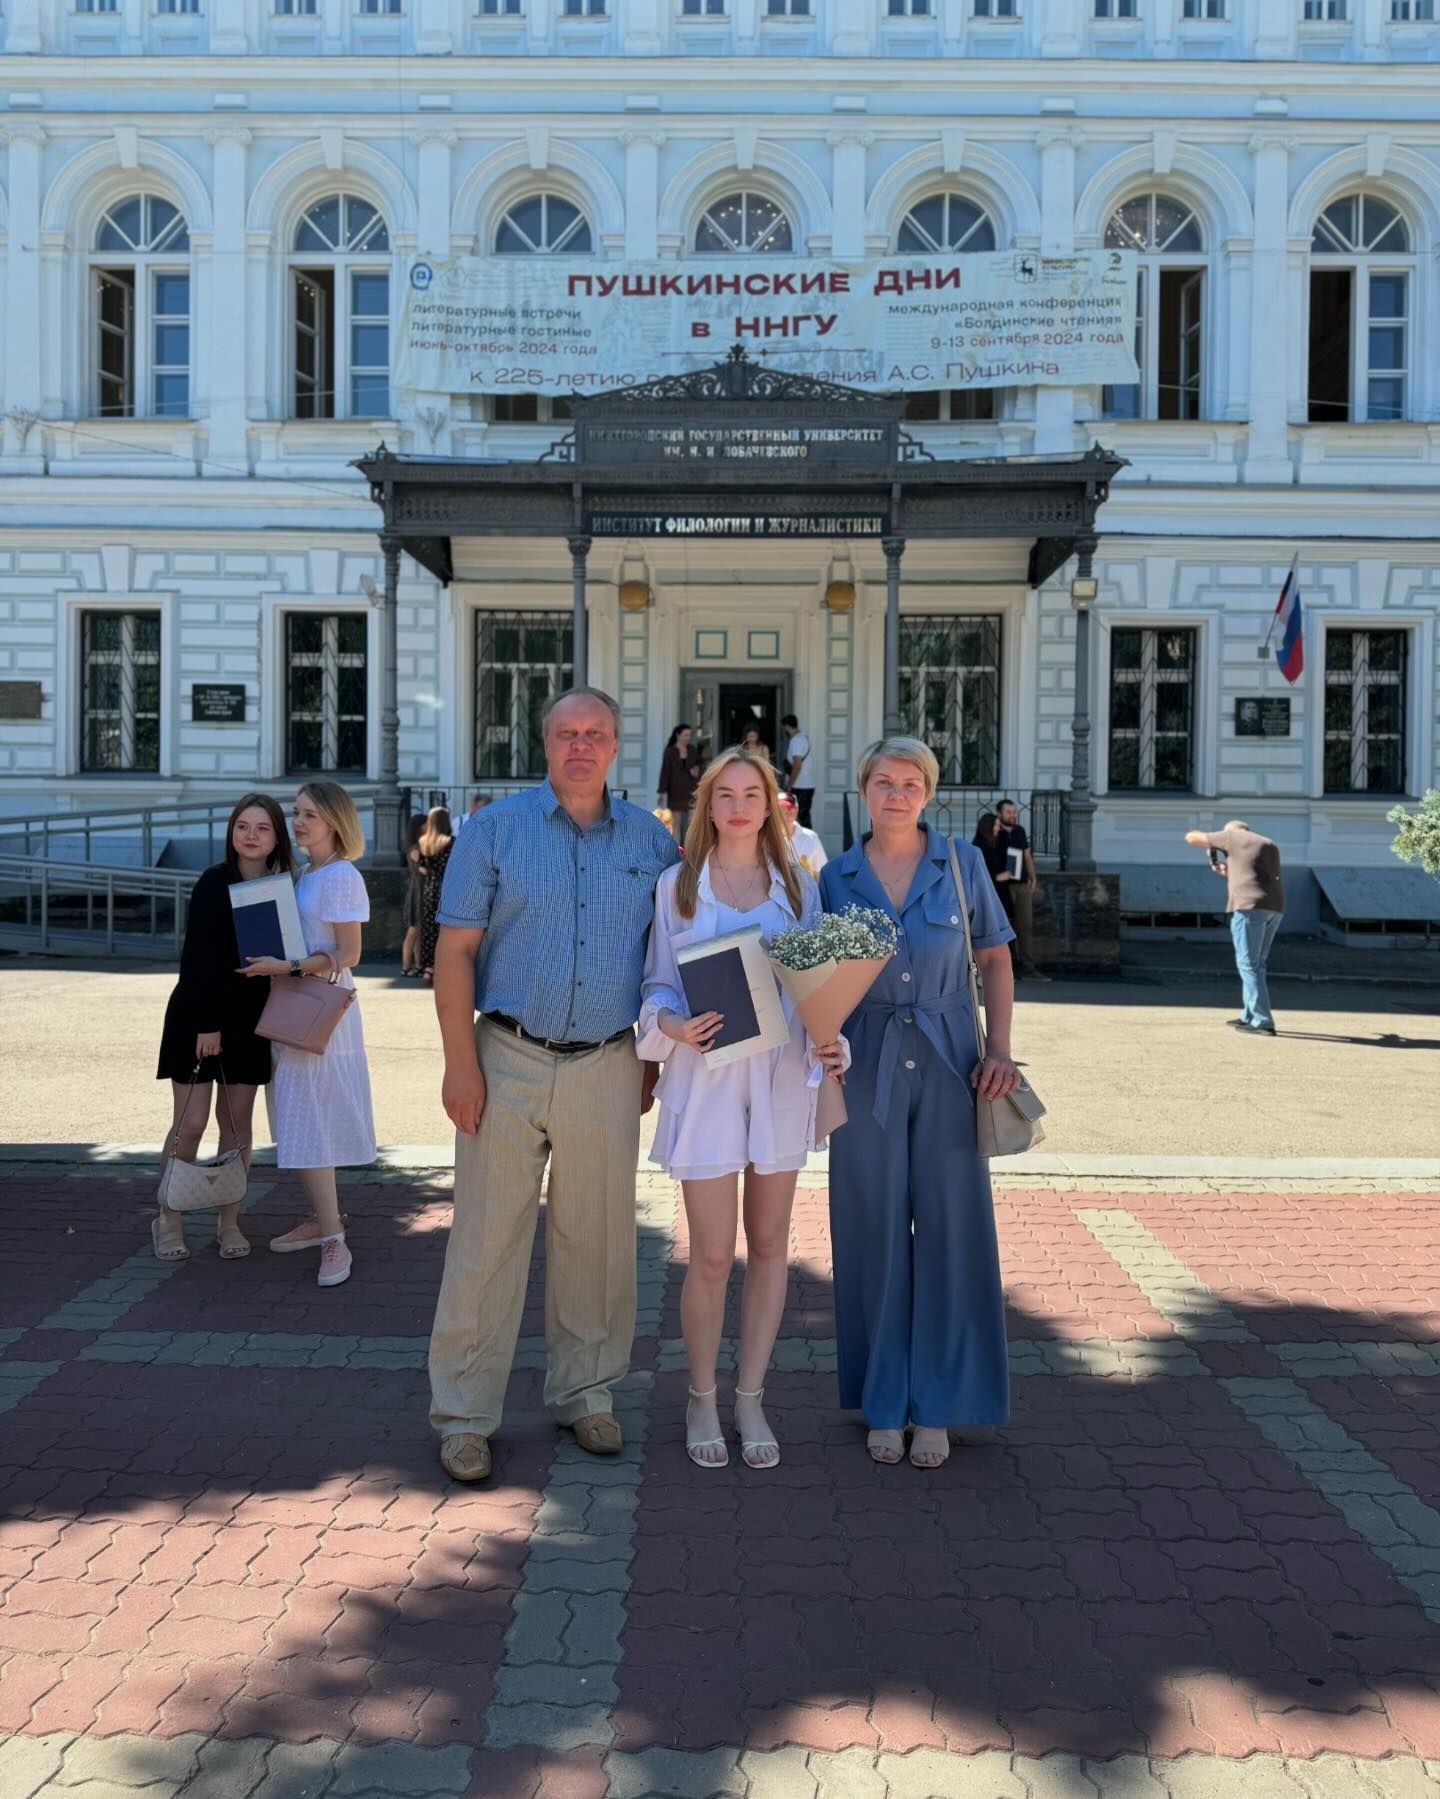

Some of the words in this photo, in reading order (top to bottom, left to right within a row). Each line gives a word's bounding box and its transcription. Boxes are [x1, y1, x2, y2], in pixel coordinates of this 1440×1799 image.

[567, 273, 850, 297] ПУШКИНСКИЕ
[873, 267, 961, 296] ДНИ
[413, 303, 517, 320] литературные
[521, 308, 582, 320] встречи
[888, 300, 1014, 315] международная
[411, 321, 517, 336] литературные
[521, 327, 592, 338] гостиные
[735, 315, 838, 337] ННГУ
[519, 343, 558, 355] 2024
[563, 345, 598, 356] года
[930, 335, 965, 350] 9-13
[970, 333, 1040, 348] сентября
[1043, 332, 1083, 345] 2024
[1089, 333, 1125, 345] года
[494, 367, 636, 387] 225-летию
[887, 364, 935, 381] А.С.
[946, 361, 1060, 381] Пушкина
[803, 428, 884, 441] УНИВЕРСИТЕТ
[592, 517, 661, 533] ИНСТИТУТ
[665, 517, 751, 533] ФИЛОЛОГИИ
[754, 517, 765, 533] И
[768, 517, 882, 533] ЖУРНАЛИСТИКИ
